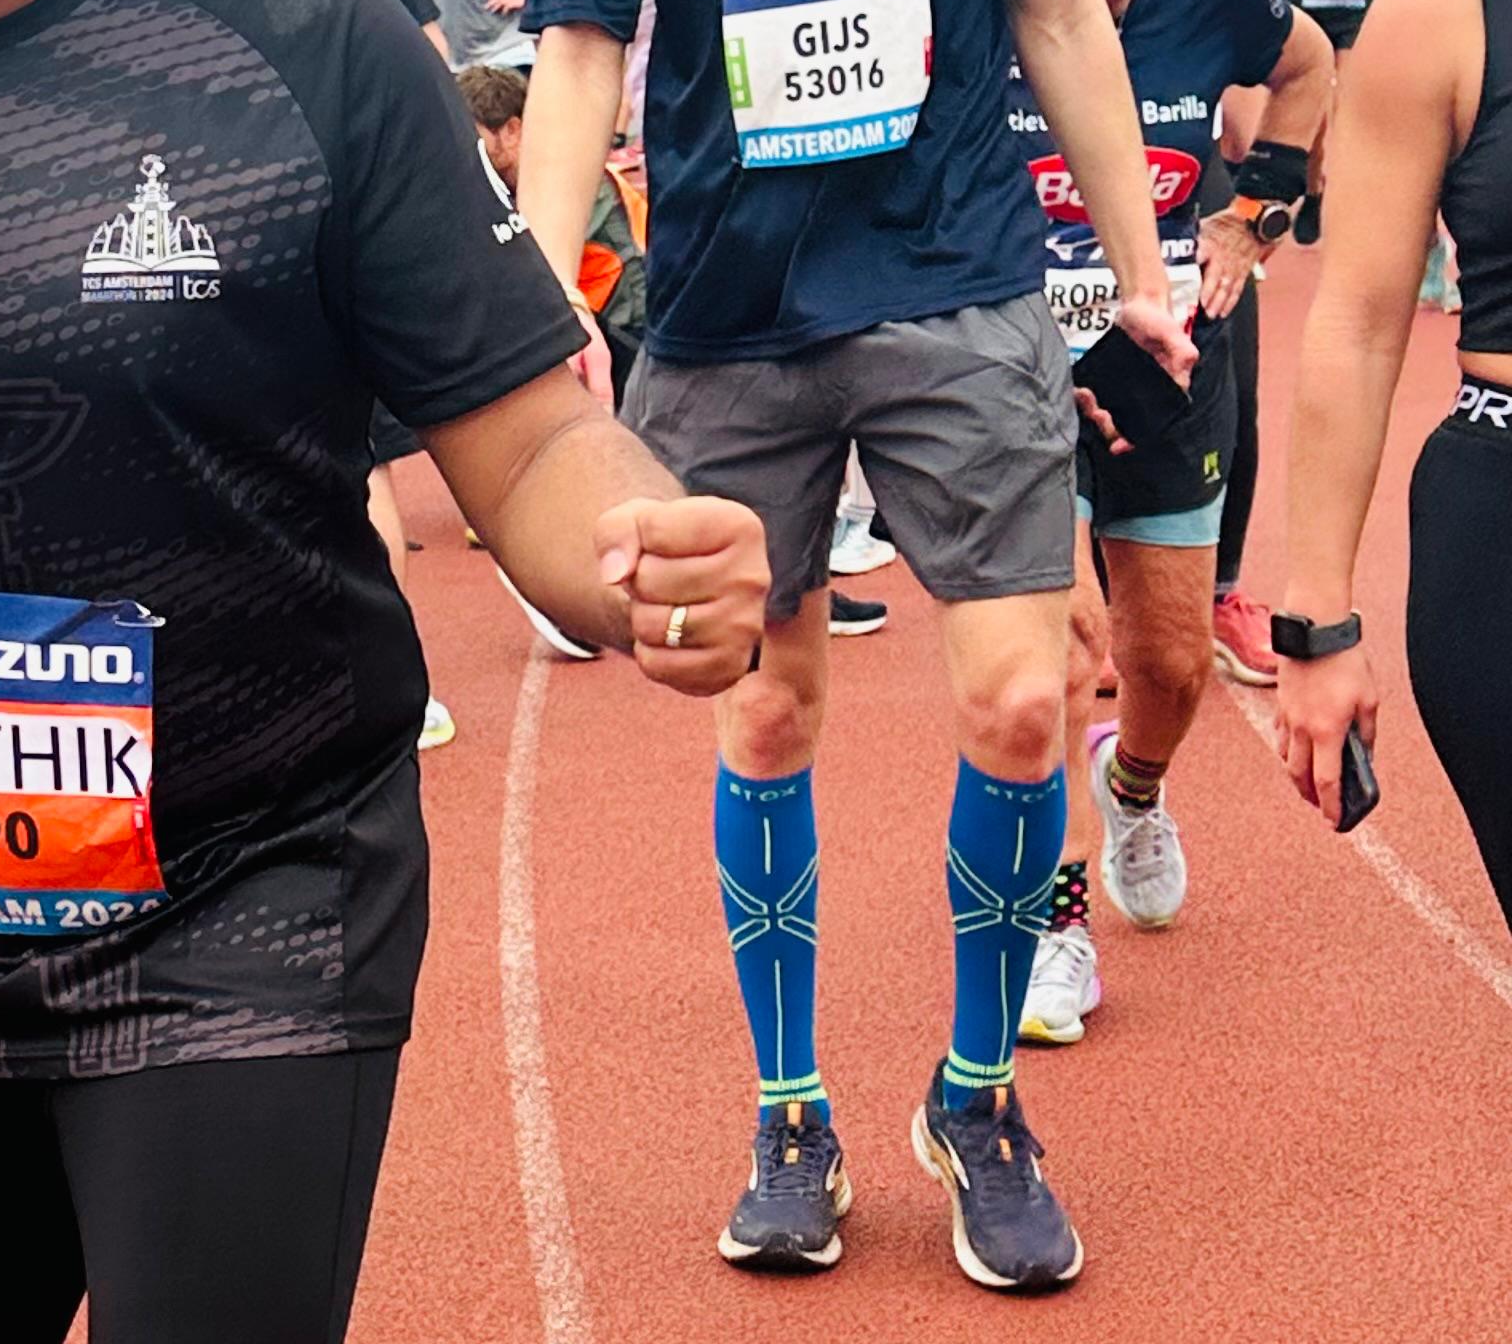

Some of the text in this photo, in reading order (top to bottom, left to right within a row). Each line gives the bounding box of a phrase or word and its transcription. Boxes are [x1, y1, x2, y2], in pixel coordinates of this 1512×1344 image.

[793, 13, 870, 57] GIJS
[784, 58, 884, 102] 53016
[1142, 94, 1208, 125] Barilla
[743, 120, 885, 161] AMSTERDAM
[81, 274, 221, 300] TCS AMSTERDAM tcs
[145, 288, 174, 301] 2024
